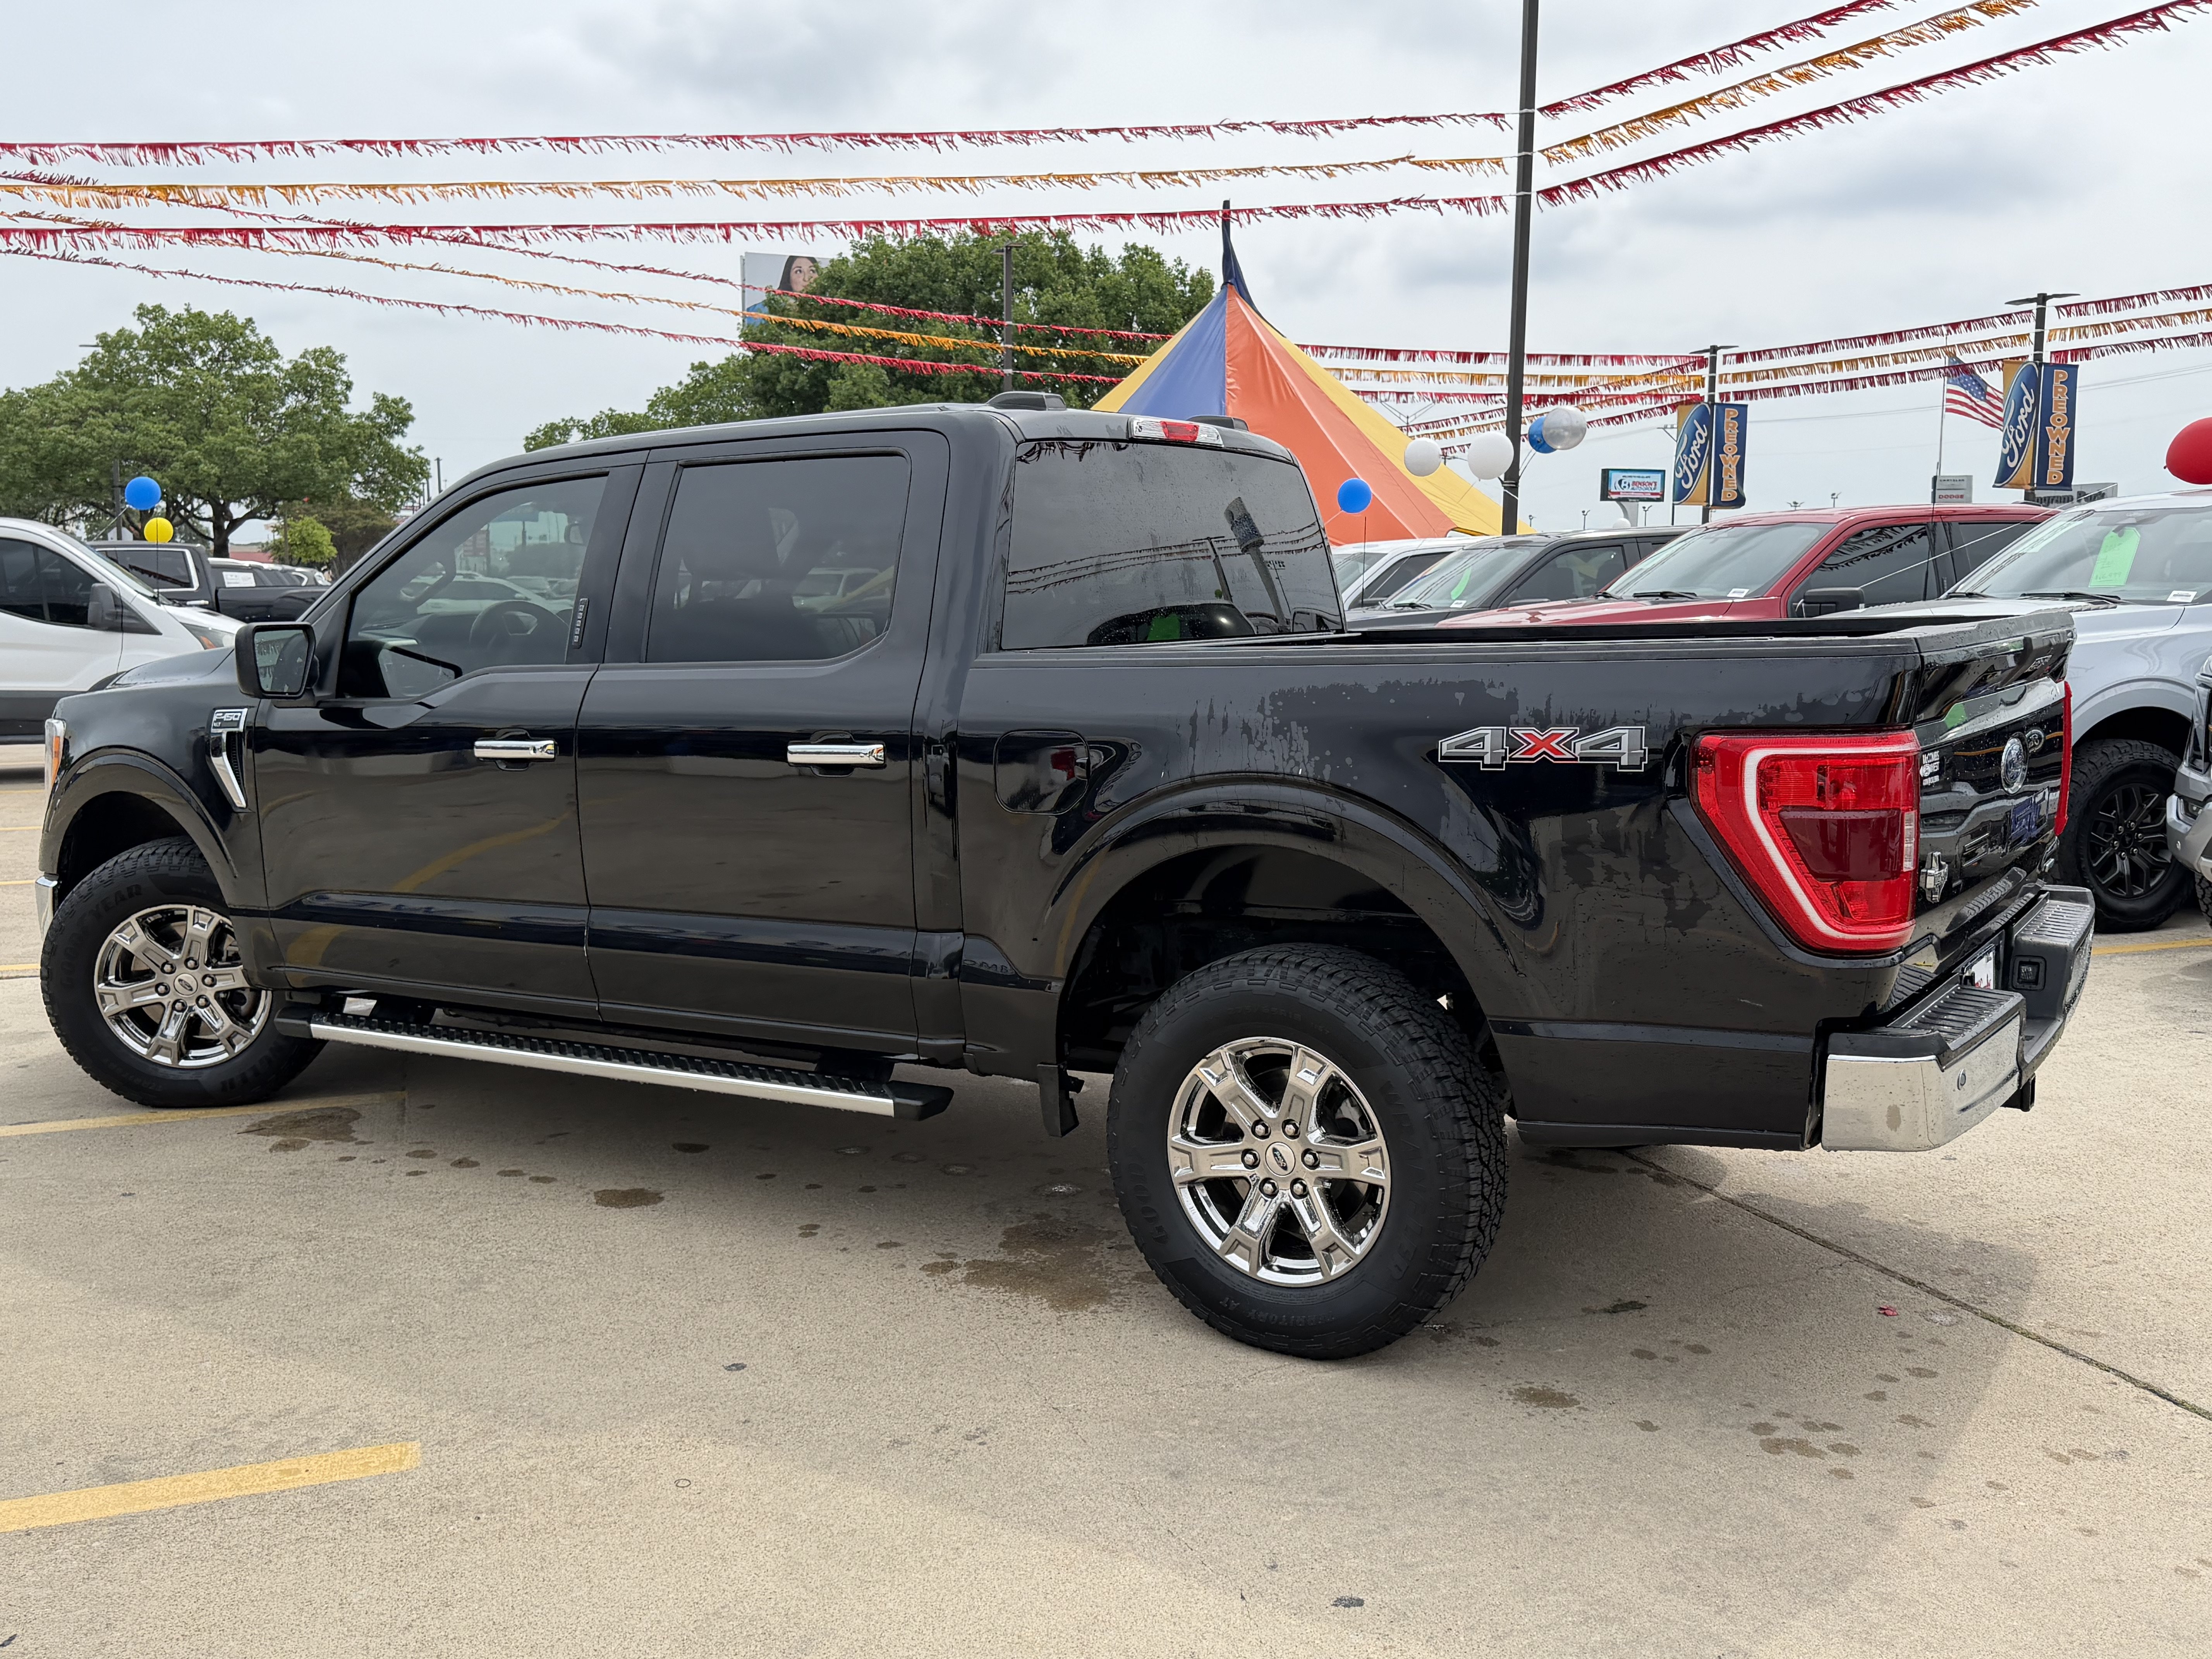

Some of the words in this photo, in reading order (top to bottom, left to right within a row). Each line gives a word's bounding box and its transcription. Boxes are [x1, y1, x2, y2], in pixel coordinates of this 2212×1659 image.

[1675, 419, 1708, 489] Ford
[1719, 408, 1741, 501] PREOWNED
[2001, 381, 2035, 468] Ford
[2045, 369, 2071, 485] PREOWNED
[213, 713, 241, 721] F-150
